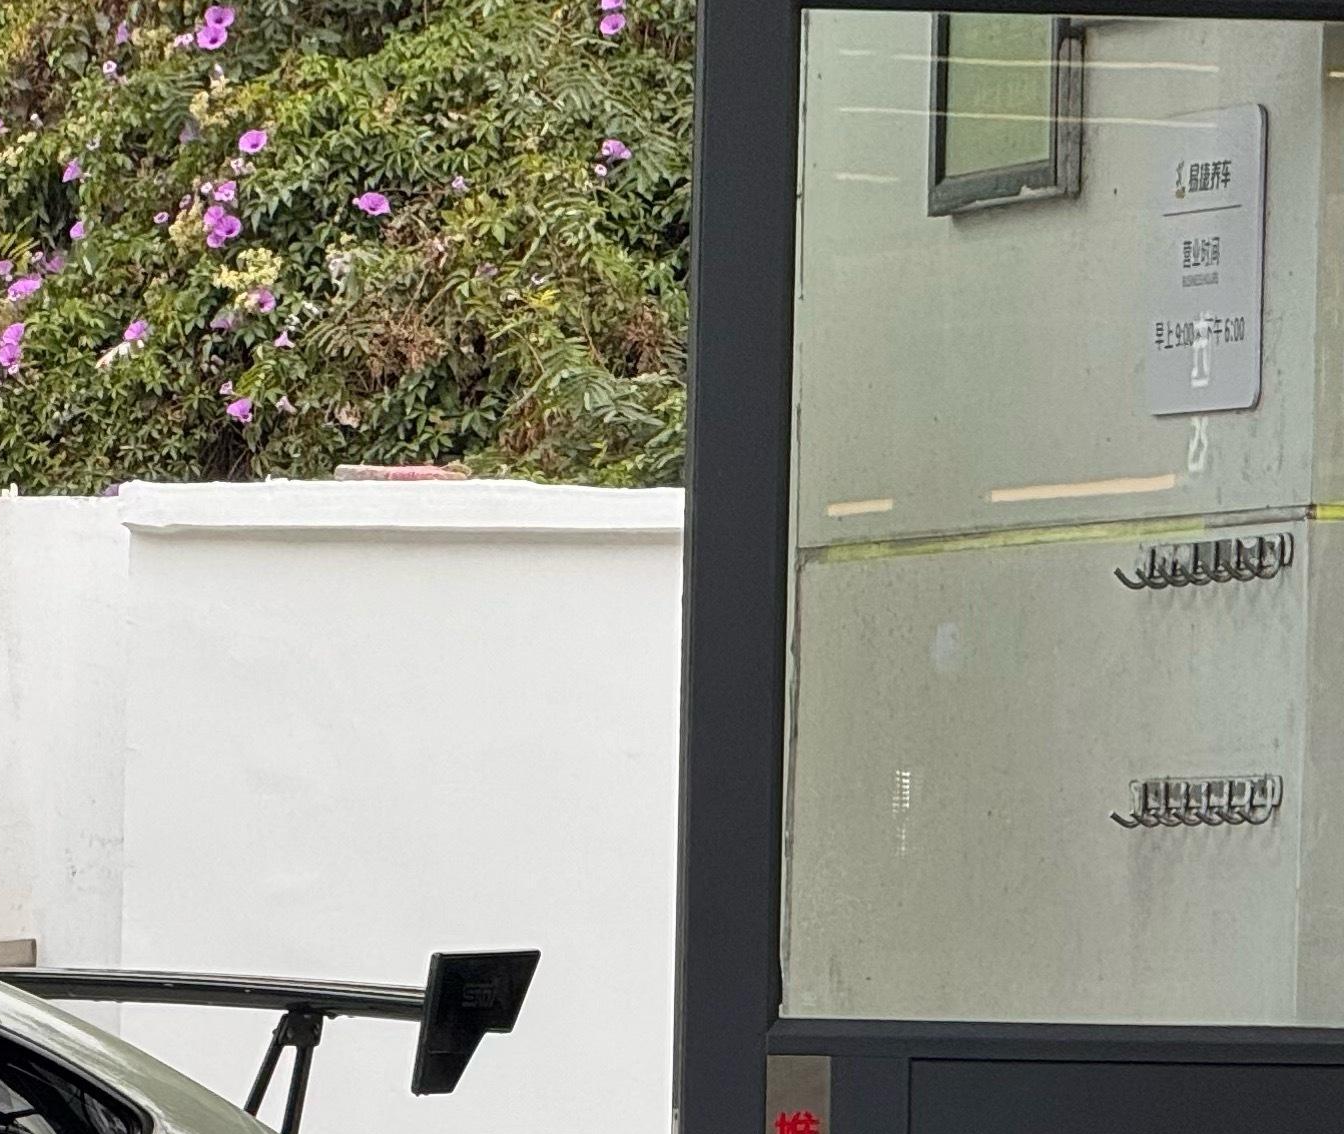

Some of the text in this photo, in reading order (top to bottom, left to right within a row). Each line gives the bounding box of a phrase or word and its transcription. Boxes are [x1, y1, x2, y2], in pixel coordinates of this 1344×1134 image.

[1188, 160, 1232, 192] 易捷养车
[1183, 237, 1220, 268] 营业时间
